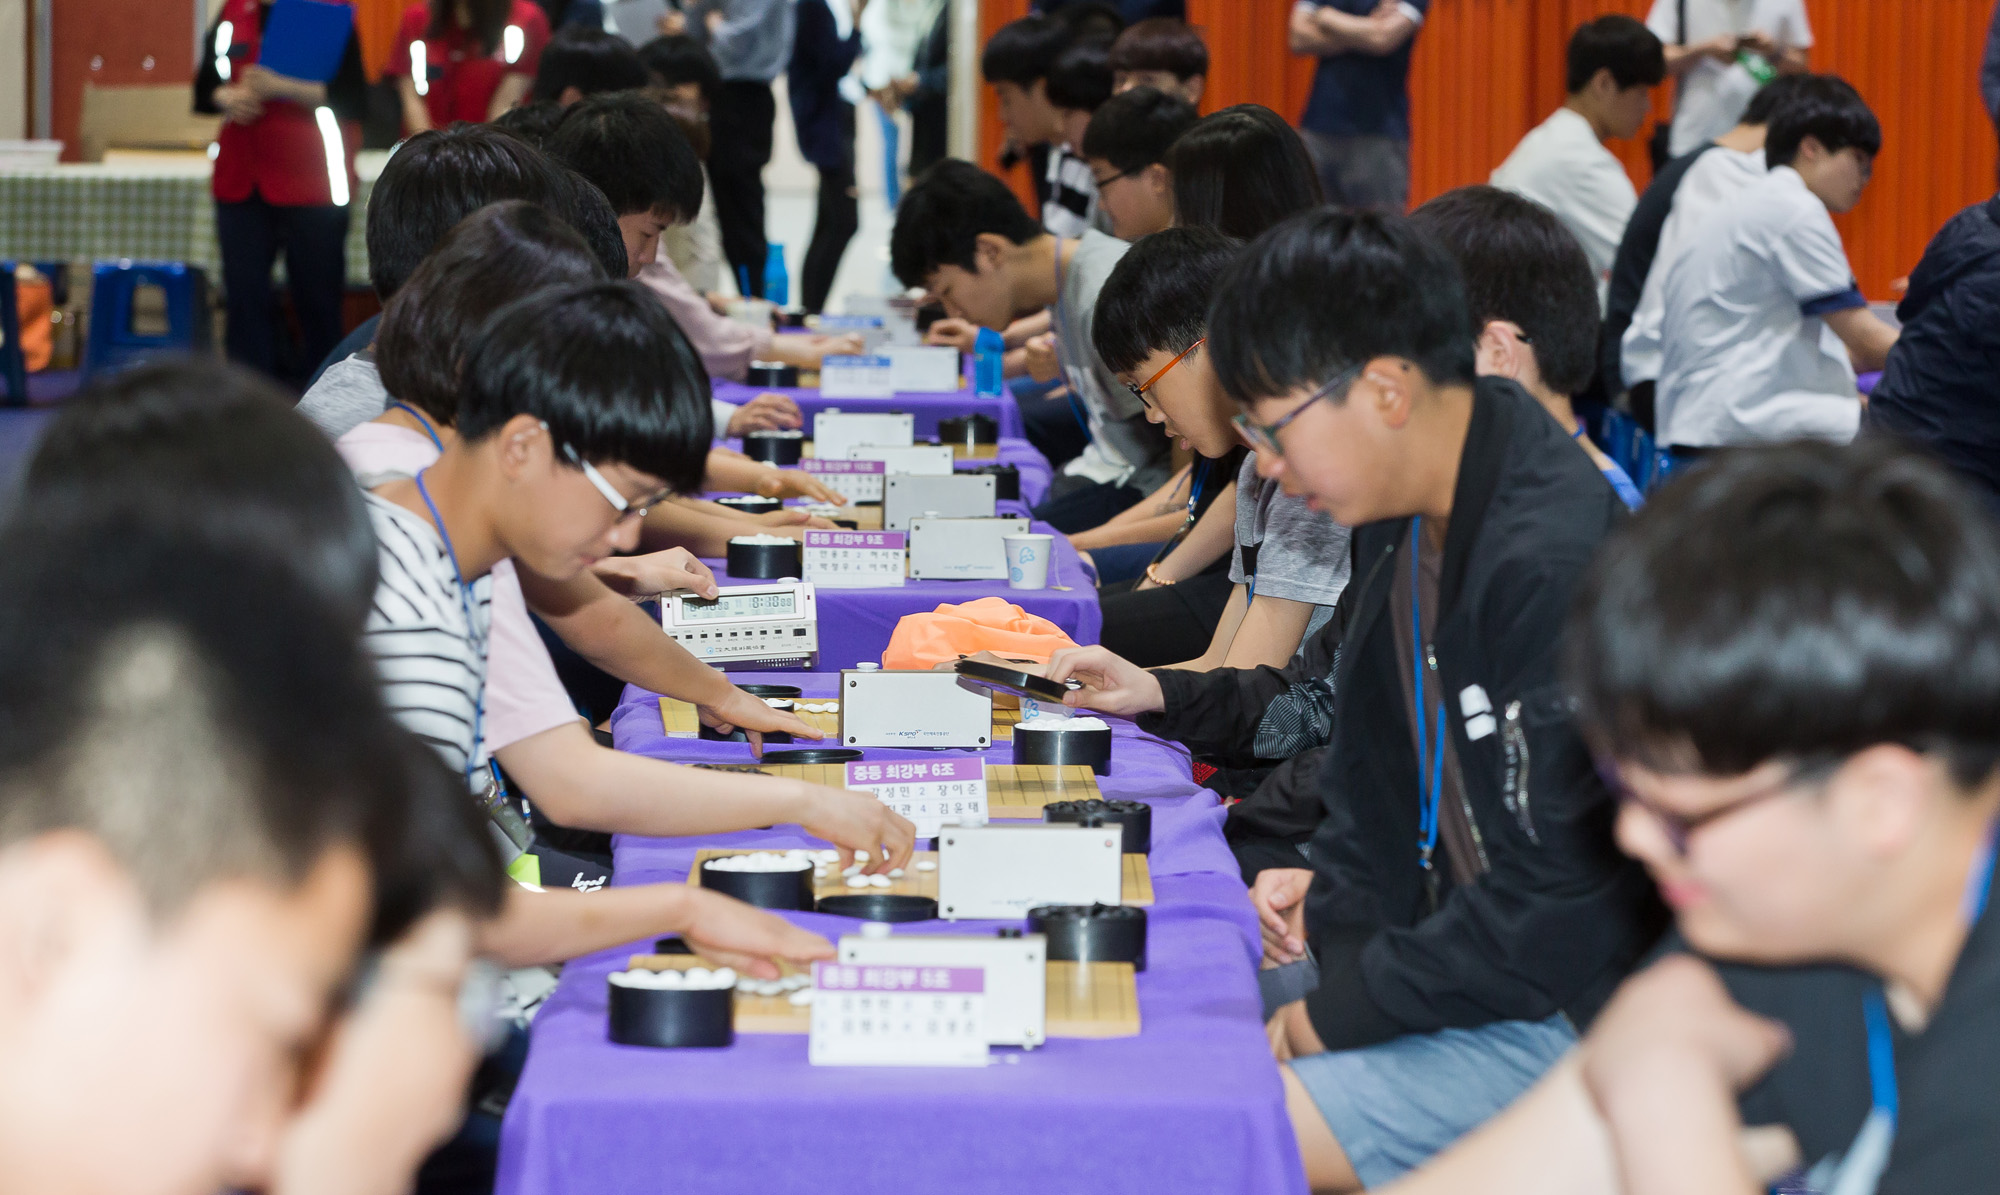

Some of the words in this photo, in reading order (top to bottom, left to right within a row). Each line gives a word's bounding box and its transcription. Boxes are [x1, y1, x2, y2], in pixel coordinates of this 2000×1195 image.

[853, 765, 882, 781] 중등
[886, 763, 928, 780] 최강부
[931, 762, 955, 777] 6조
[919, 787, 926, 796] 2
[938, 784, 978, 797] 장이준
[920, 804, 927, 813] 4
